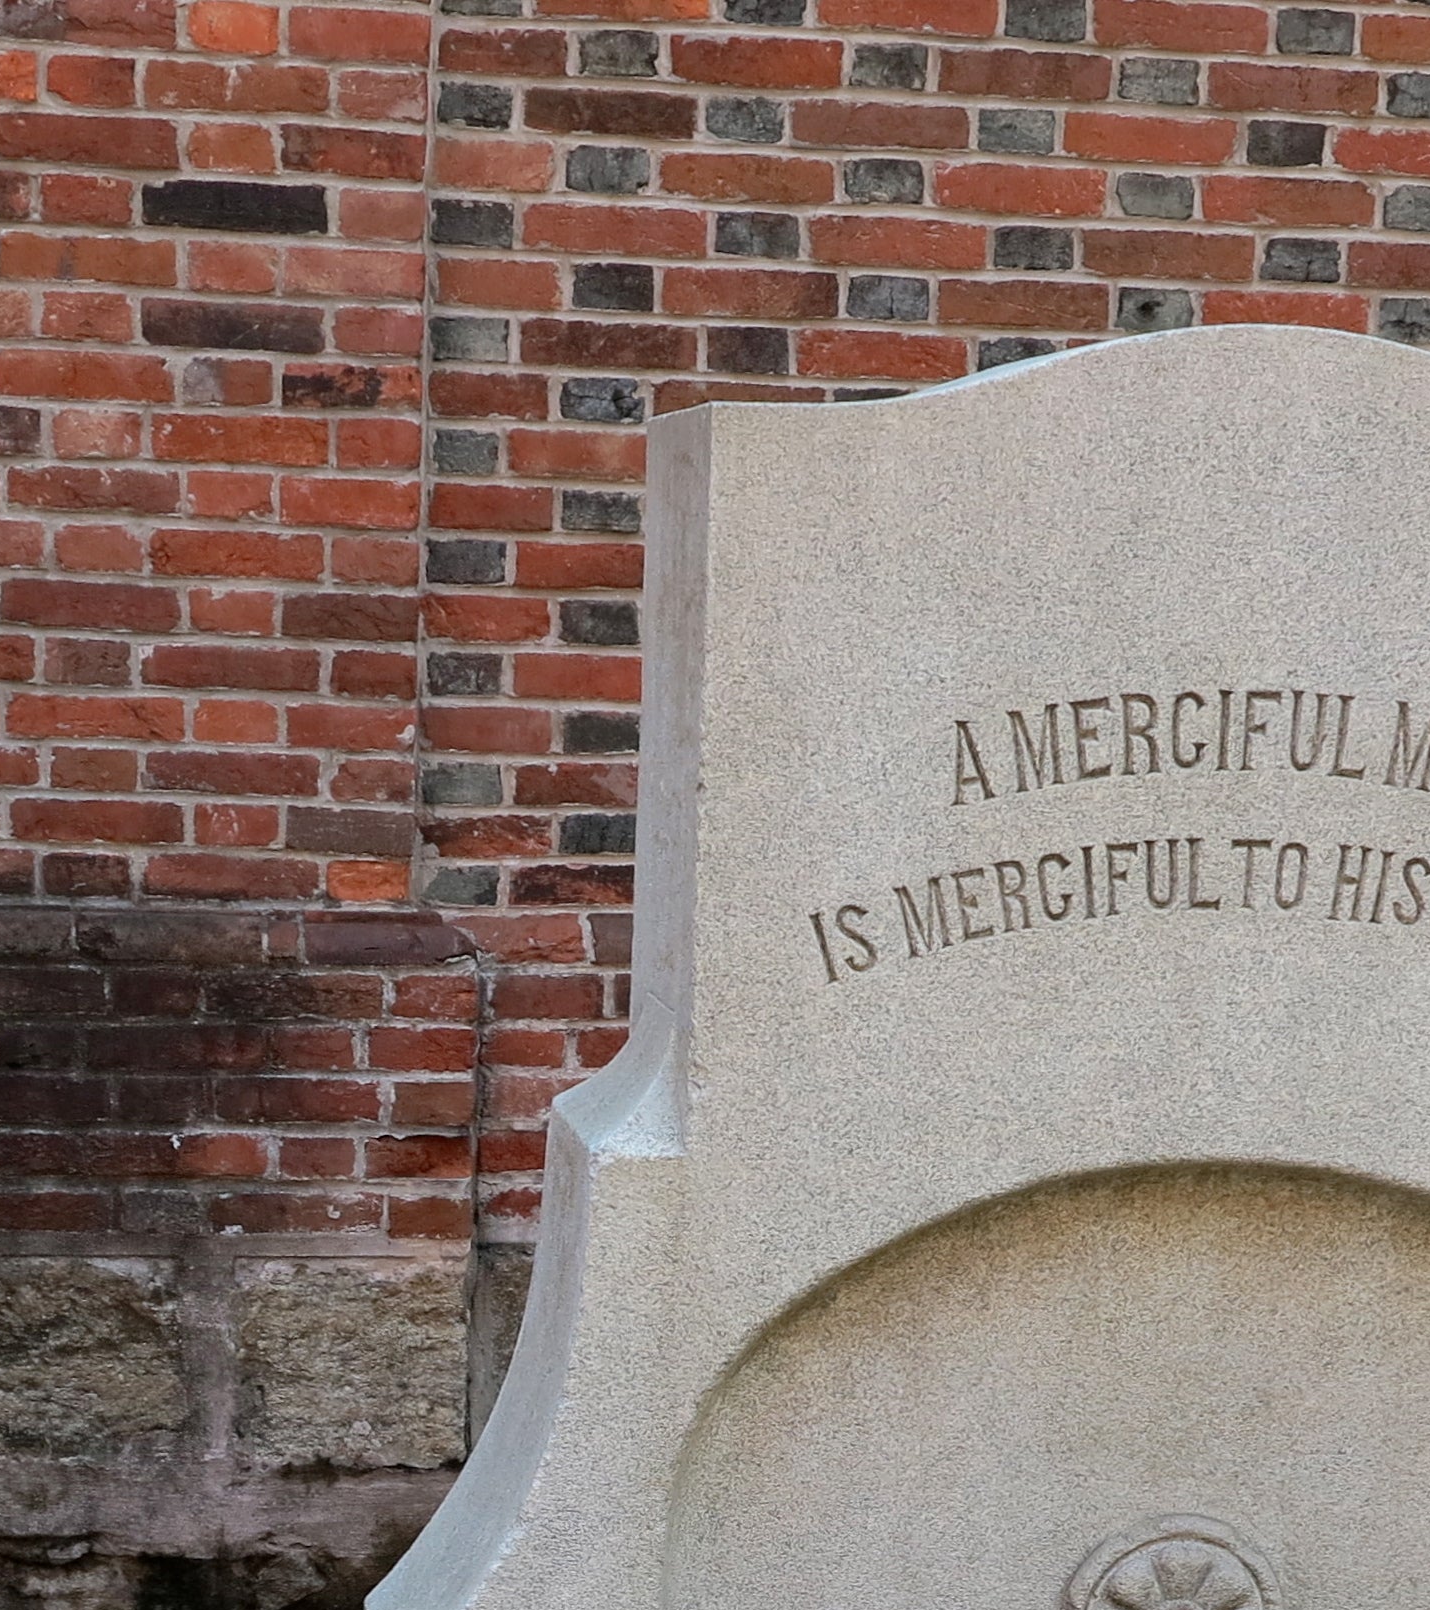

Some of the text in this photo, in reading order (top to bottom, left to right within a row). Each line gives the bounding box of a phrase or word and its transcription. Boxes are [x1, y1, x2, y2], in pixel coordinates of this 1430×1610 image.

[950, 719, 995, 806] A
[1006, 690, 1366, 793] MERCIFUL
[808, 903, 880, 985] IS
[892, 837, 1224, 960] MERCIFUL
[1231, 838, 1310, 911] TO
